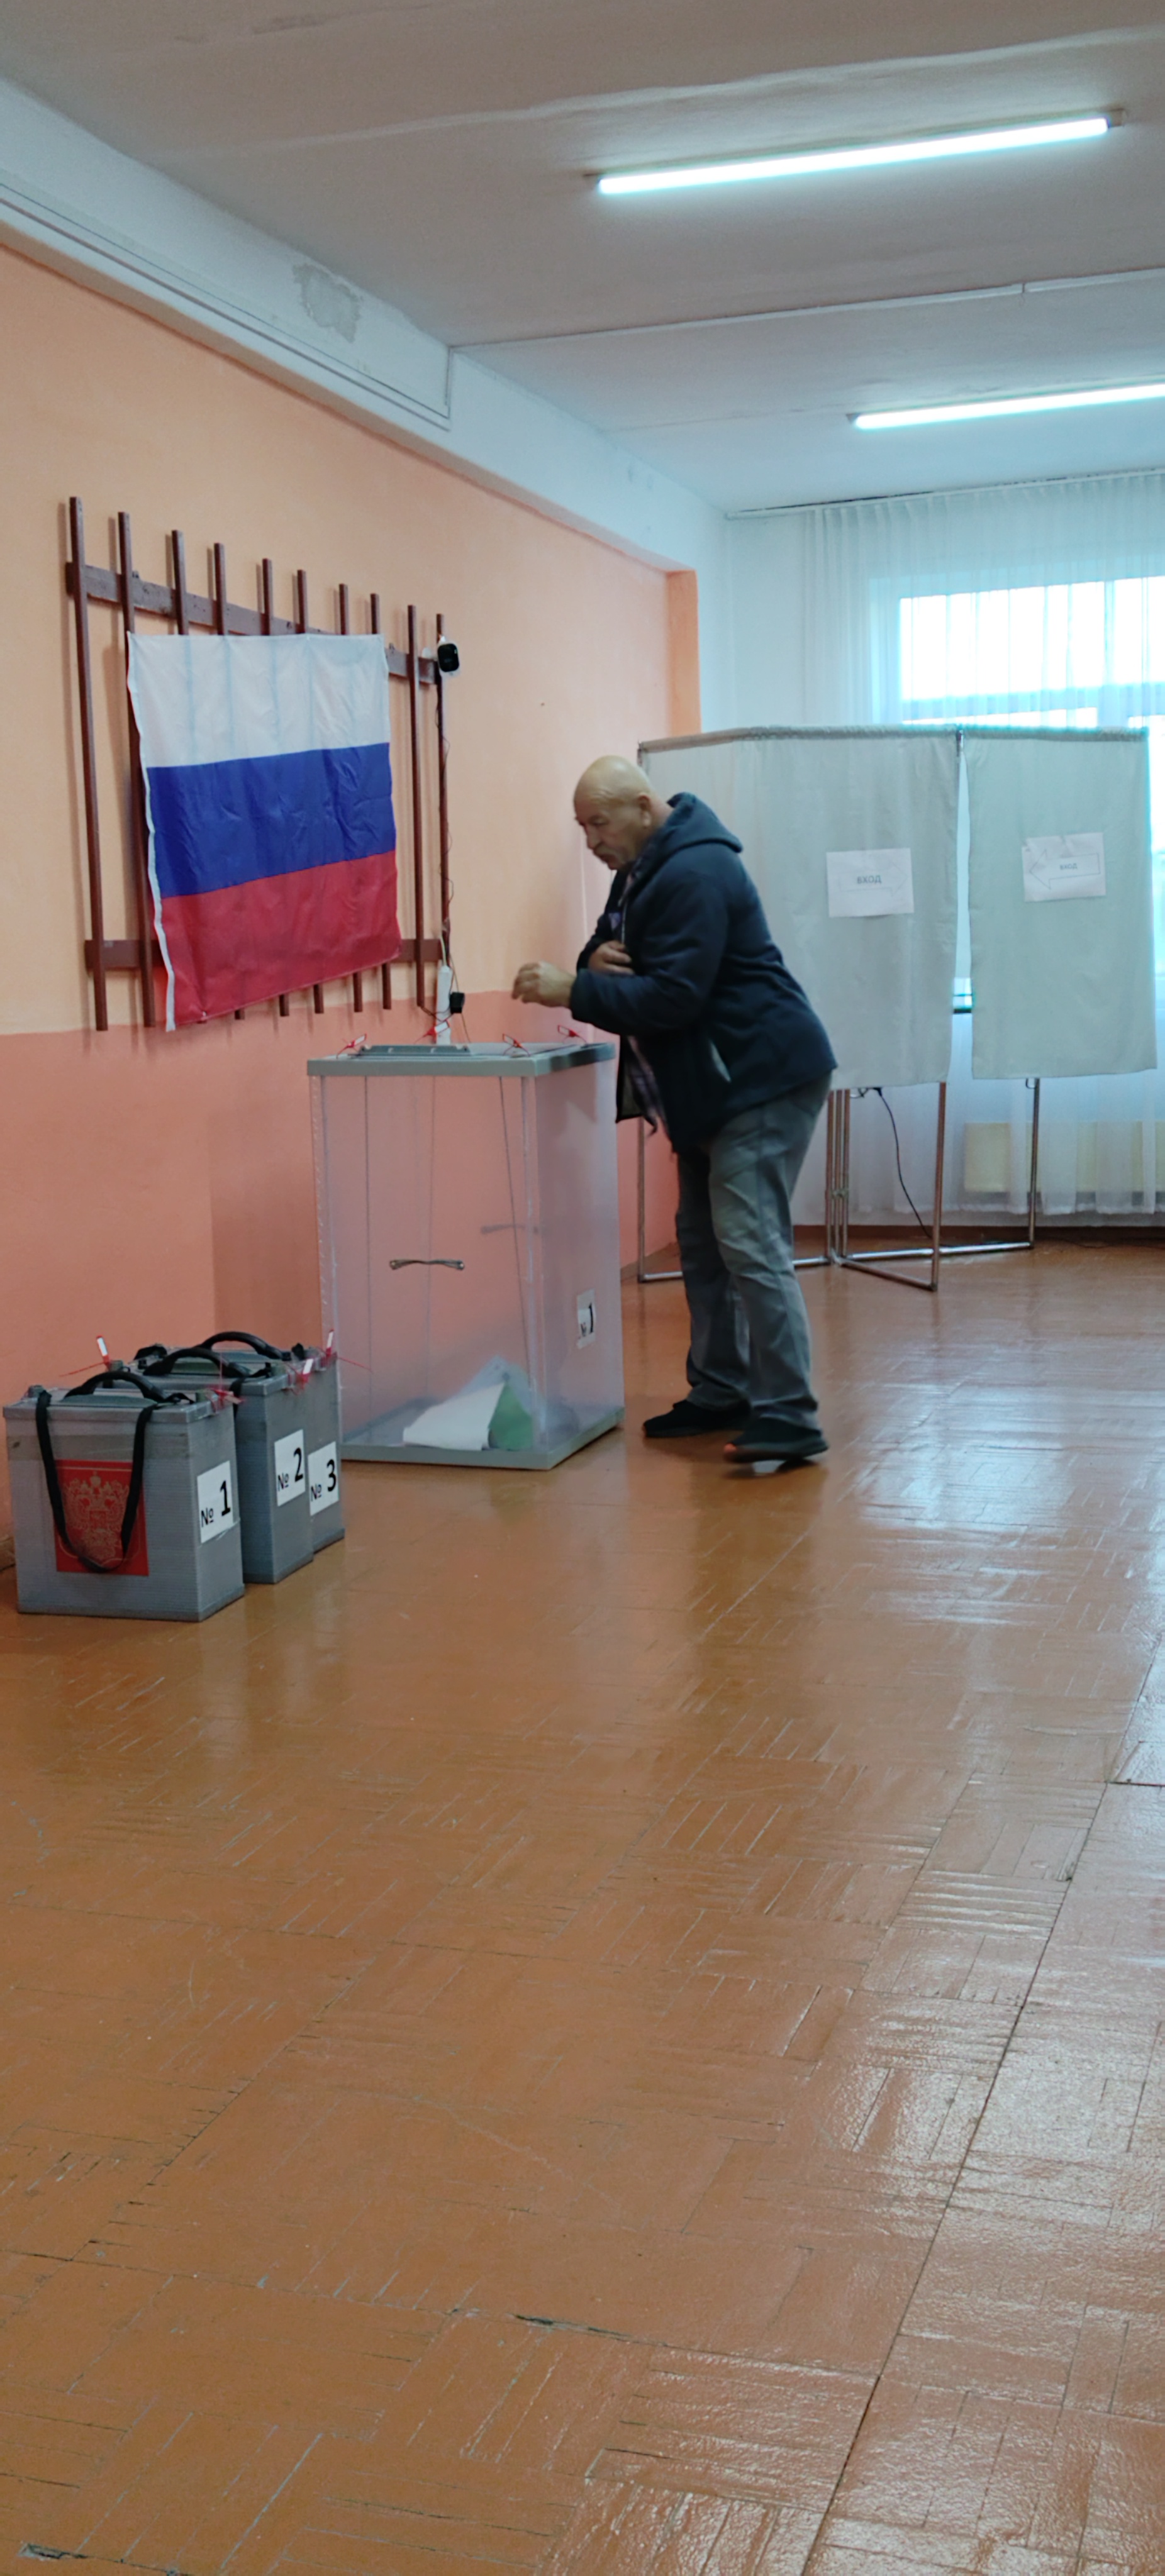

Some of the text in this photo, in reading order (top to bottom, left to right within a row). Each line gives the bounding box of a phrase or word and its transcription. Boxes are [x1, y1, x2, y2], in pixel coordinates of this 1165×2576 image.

[588, 1302, 594, 1334] 1
[294, 1447, 304, 1482] 2
[326, 1459, 337, 1492] 3
[220, 1480, 231, 1516] 1
